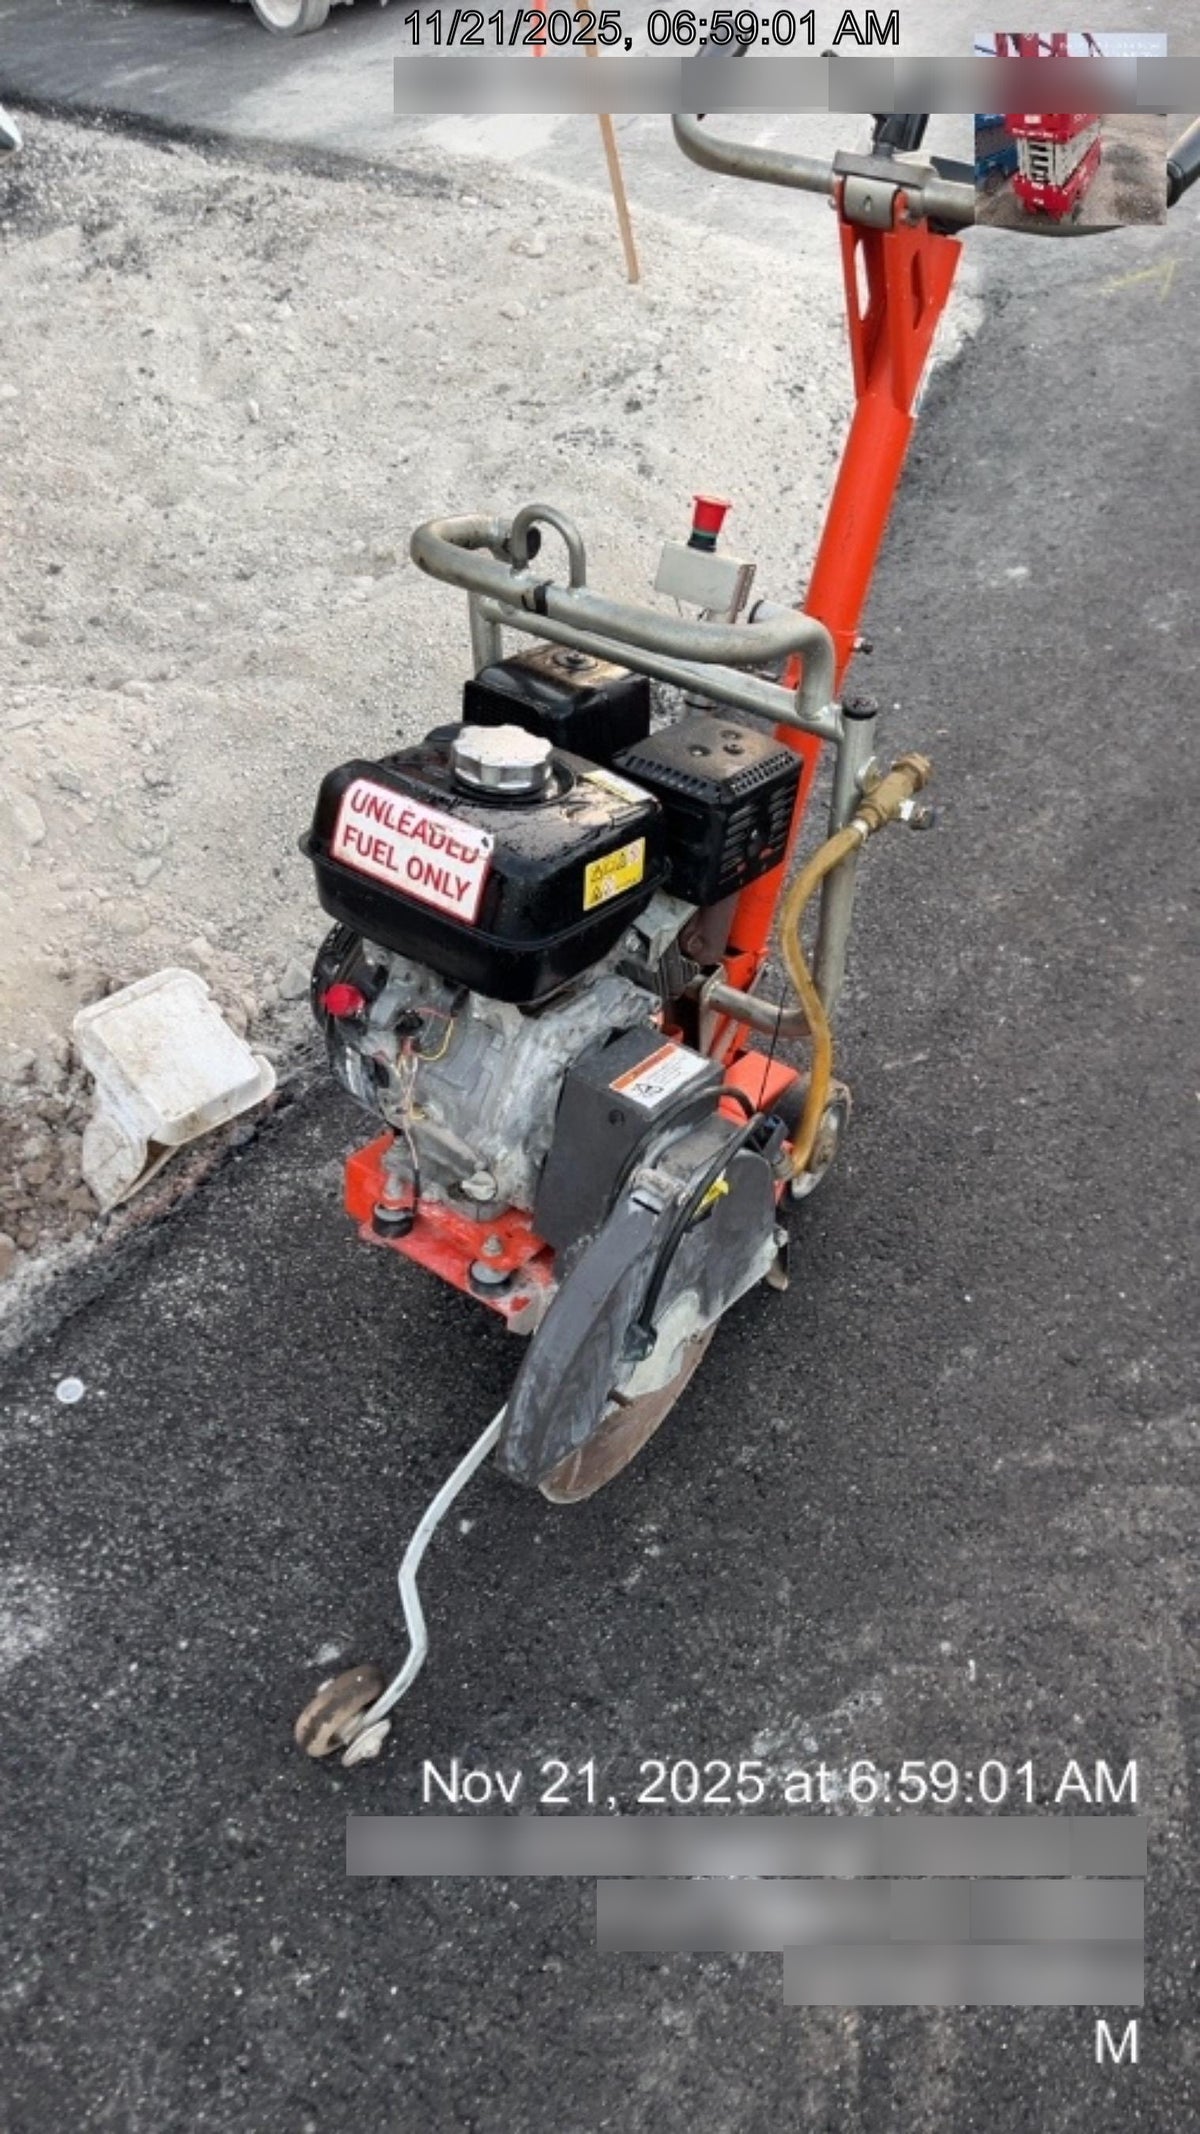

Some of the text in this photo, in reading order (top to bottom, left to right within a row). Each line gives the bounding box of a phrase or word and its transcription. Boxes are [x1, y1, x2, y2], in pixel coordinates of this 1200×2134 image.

[343, 824, 471, 902] FUEL ONLY
[350, 788, 480, 865] UNLEADED
